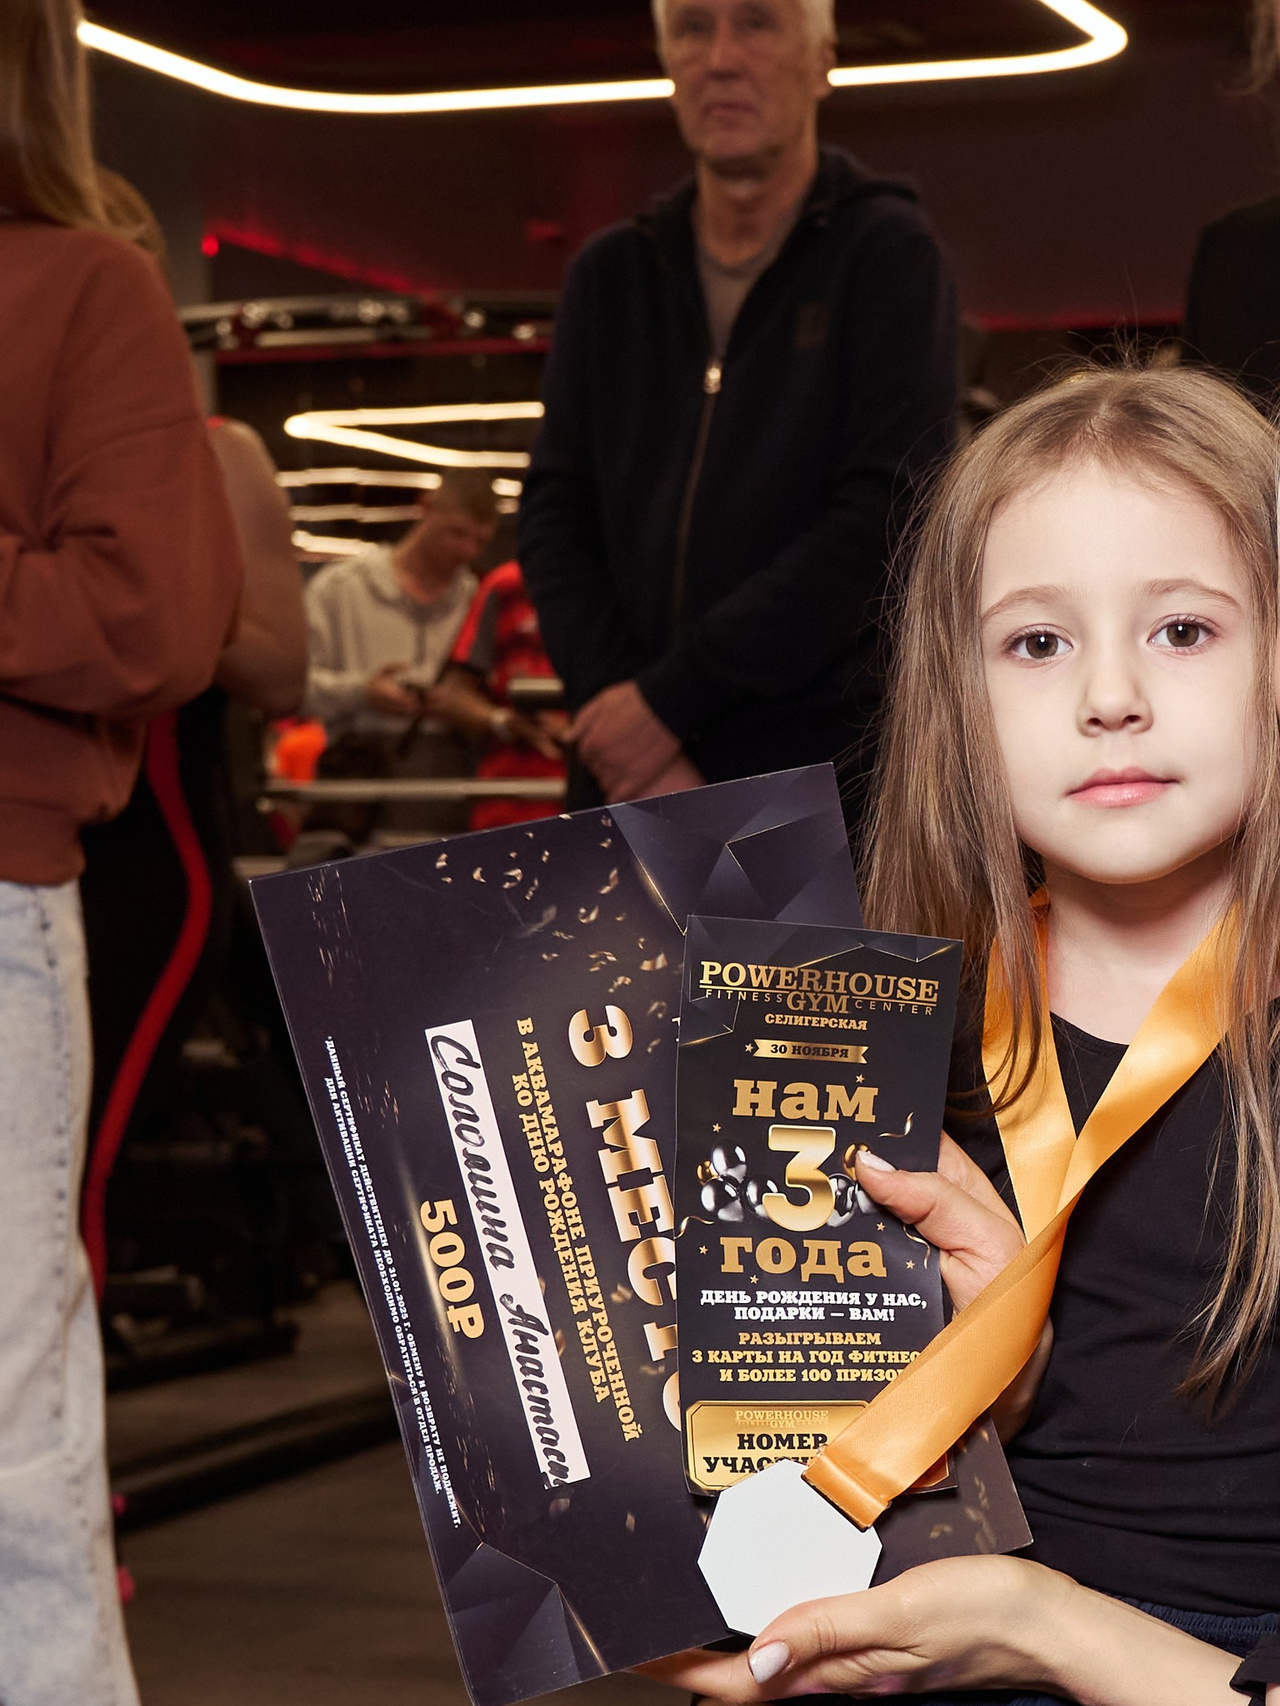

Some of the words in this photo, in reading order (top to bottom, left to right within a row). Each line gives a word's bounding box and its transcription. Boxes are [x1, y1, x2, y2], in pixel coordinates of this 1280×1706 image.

[700, 960, 939, 1000] POWERHOUSE
[705, 989, 783, 1003] FITNESS
[786, 991, 850, 1014] GYM
[855, 1001, 932, 1015] CENTER
[517, 1018, 533, 1035] В
[569, 1005, 633, 1067] 3
[764, 1013, 868, 1030] СЕЛИГЕРСКАЯ
[770, 1043, 787, 1054] 30
[791, 1045, 849, 1058] НОЯБРЯ
[325, 1078, 337, 1100] ДЛЯ
[512, 1073, 532, 1106] КО
[333, 1103, 356, 1167] АКТИВАЦИИ
[340, 1091, 365, 1161] СЕРТИФИКАТ
[519, 1113, 549, 1172] ДНЮ
[522, 1042, 585, 1240] АКВАМАРАФОНЕ
[762, 1124, 837, 1232] 3
[352, 1170, 378, 1247] СЕРТИФИКАТА
[359, 1165, 388, 1247] ДЕЙСТВИТЕЛЕН
[383, 1250, 393, 1264] ДО
[539, 1178, 587, 1314] РОЖДЕНИЯ
[719, 1236, 887, 1283] года
[374, 1250, 399, 1323] НЕОБХОДИМО
[389, 1267, 408, 1319] 31.01.2025
[700, 1290, 752, 1305] ДЕНЬ
[756, 1290, 860, 1305] РОЖДЕНИЯ
[865, 1293, 878, 1305] У
[882, 1293, 927, 1309] НАС,
[404, 1322, 410, 1331] Г.
[734, 1307, 826, 1321] ПОДАРКИ
[849, 1308, 895, 1321] ВАМ!
[407, 1334, 423, 1376] ОБМЕНУ
[575, 1245, 642, 1441] ПРИУРОЧЕННОЙ
[738, 1332, 881, 1345] РАЗЫГРЫВАЕМ
[395, 1326, 419, 1395] ОБРАТИТЬСЯ
[577, 1319, 610, 1402] КЛУБА
[692, 1350, 702, 1363] 3
[707, 1350, 774, 1363] КАРТЫ
[779, 1351, 805, 1364] НА
[809, 1350, 844, 1365] ГОД
[720, 1369, 733, 1381] И
[738, 1369, 797, 1382] БОЛЕЕ
[801, 1369, 832, 1382] 100
[836, 1369, 904, 1382] ПРИЗО
[414, 1397, 420, 1405] В
[419, 1380, 426, 1388] И
[416, 1407, 430, 1442] ОТДЕЛ
[420, 1391, 440, 1445] ВОЗВРАТУ
[734, 1410, 829, 1420] POWERHOUSE
[769, 1420, 795, 1428] GYM
[436, 1448, 444, 1462] НЕ
[737, 1433, 828, 1450] НОМЕР
[425, 1445, 443, 1494] ПРОДАЖ.
[440, 1465, 461, 1528] ПОДЛЕЖИТ.
